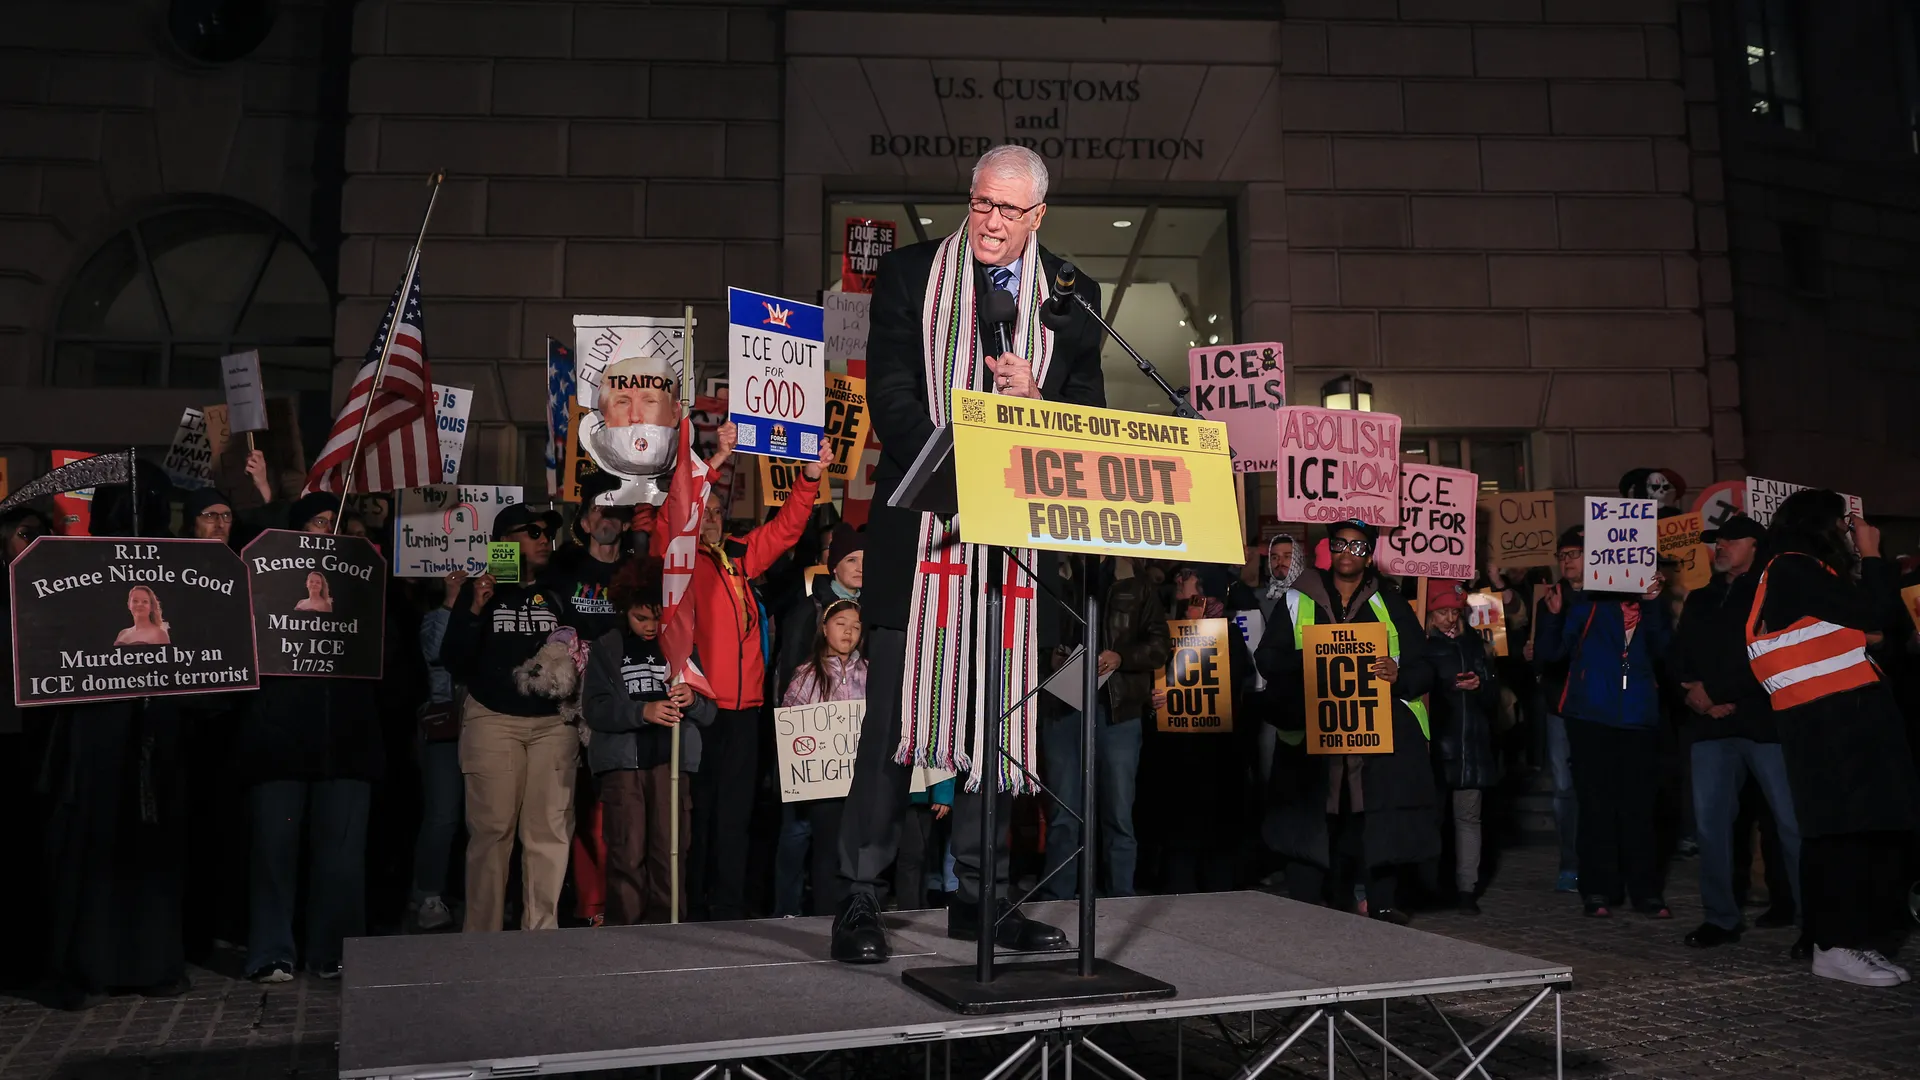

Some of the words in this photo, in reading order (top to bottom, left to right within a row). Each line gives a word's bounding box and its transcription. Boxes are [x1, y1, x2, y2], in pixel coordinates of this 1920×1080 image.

[934, 77, 982, 99] U.S.
[994, 78, 1139, 101] CUSTOMS
[1015, 108, 1059, 129] and
[1003, 137, 1204, 159] OTECTION
[880, 228, 893, 242] SE
[843, 317, 860, 331] La
[579, 326, 622, 388] FLUSH
[742, 334, 772, 361] ICE
[782, 340, 817, 368] OUT
[765, 366, 784, 378] FOR
[1200, 349, 1264, 380] I.C.E.
[608, 374, 673, 393] TRAITOR
[833, 378, 852, 391] TELL
[443, 388, 456, 409] is
[745, 376, 805, 419] GOOD
[1195, 379, 1284, 411] KILLS
[824, 400, 863, 439] CE
[996, 403, 1190, 445] BIT.LY/ICE-OUT-SENATE
[1282, 410, 1397, 460] ABOLISH
[443, 454, 456, 474] is
[828, 463, 848, 475] OOD
[1234, 459, 1277, 472] EPINK
[1020, 447, 1088, 499] ICE
[1097, 455, 1177, 506] OUT
[1288, 456, 1342, 501] I.C.E.
[1342, 460, 1398, 493] NOW
[457, 487, 489, 503] this
[496, 486, 514, 505] be
[456, 512, 464, 522] a
[1303, 503, 1386, 523] CODEPINK
[1401, 507, 1423, 527] UT
[1429, 510, 1467, 534] FOR
[1500, 498, 1553, 524] OUT
[1591, 501, 1655, 520] DE-ICE
[1028, 502, 1092, 541] FOR
[1099, 508, 1183, 547] GOOD
[1658, 517, 1699, 537] LOVE
[299, 535, 336, 551] R.I.P.
[402, 524, 448, 552] turning
[1389, 525, 1464, 557] GOOD
[1500, 530, 1554, 550] GOOD
[1607, 528, 1638, 543] OUR
[114, 544, 160, 560] R.I.P.
[1589, 546, 1656, 567] STREETS
[253, 556, 316, 575] Renee
[321, 554, 373, 581] Good
[1390, 558, 1471, 577] CODEPINK
[32, 570, 103, 599] Renee
[108, 564, 176, 583] Nicole
[181, 568, 234, 596] Good
[267, 613, 359, 634] Murdered
[1178, 625, 1200, 636] TELL
[1170, 636, 1217, 648] ONGRESS:
[1331, 630, 1357, 642] TELL
[60, 646, 168, 669] Murdered
[172, 646, 195, 667] by
[201, 647, 223, 662] an
[281, 637, 303, 658] by
[308, 638, 345, 655] ICE
[1315, 642, 1376, 655] CONGRESS:
[292, 658, 334, 673] 1/7/25
[1165, 647, 1219, 687] ICE
[30, 675, 75, 695] ICE
[81, 670, 169, 691] domestic
[175, 666, 249, 686] terrorist
[1315, 655, 1378, 699] ICE
[1166, 688, 1220, 715] OUT
[778, 703, 838, 736] STOP
[1168, 716, 1188, 728] FOR
[1192, 716, 1221, 728] GOOD
[1318, 699, 1379, 733] OUT
[1319, 734, 1343, 748] FOR
[1347, 733, 1380, 747] GOOD
[791, 758, 857, 785] NEIGH
